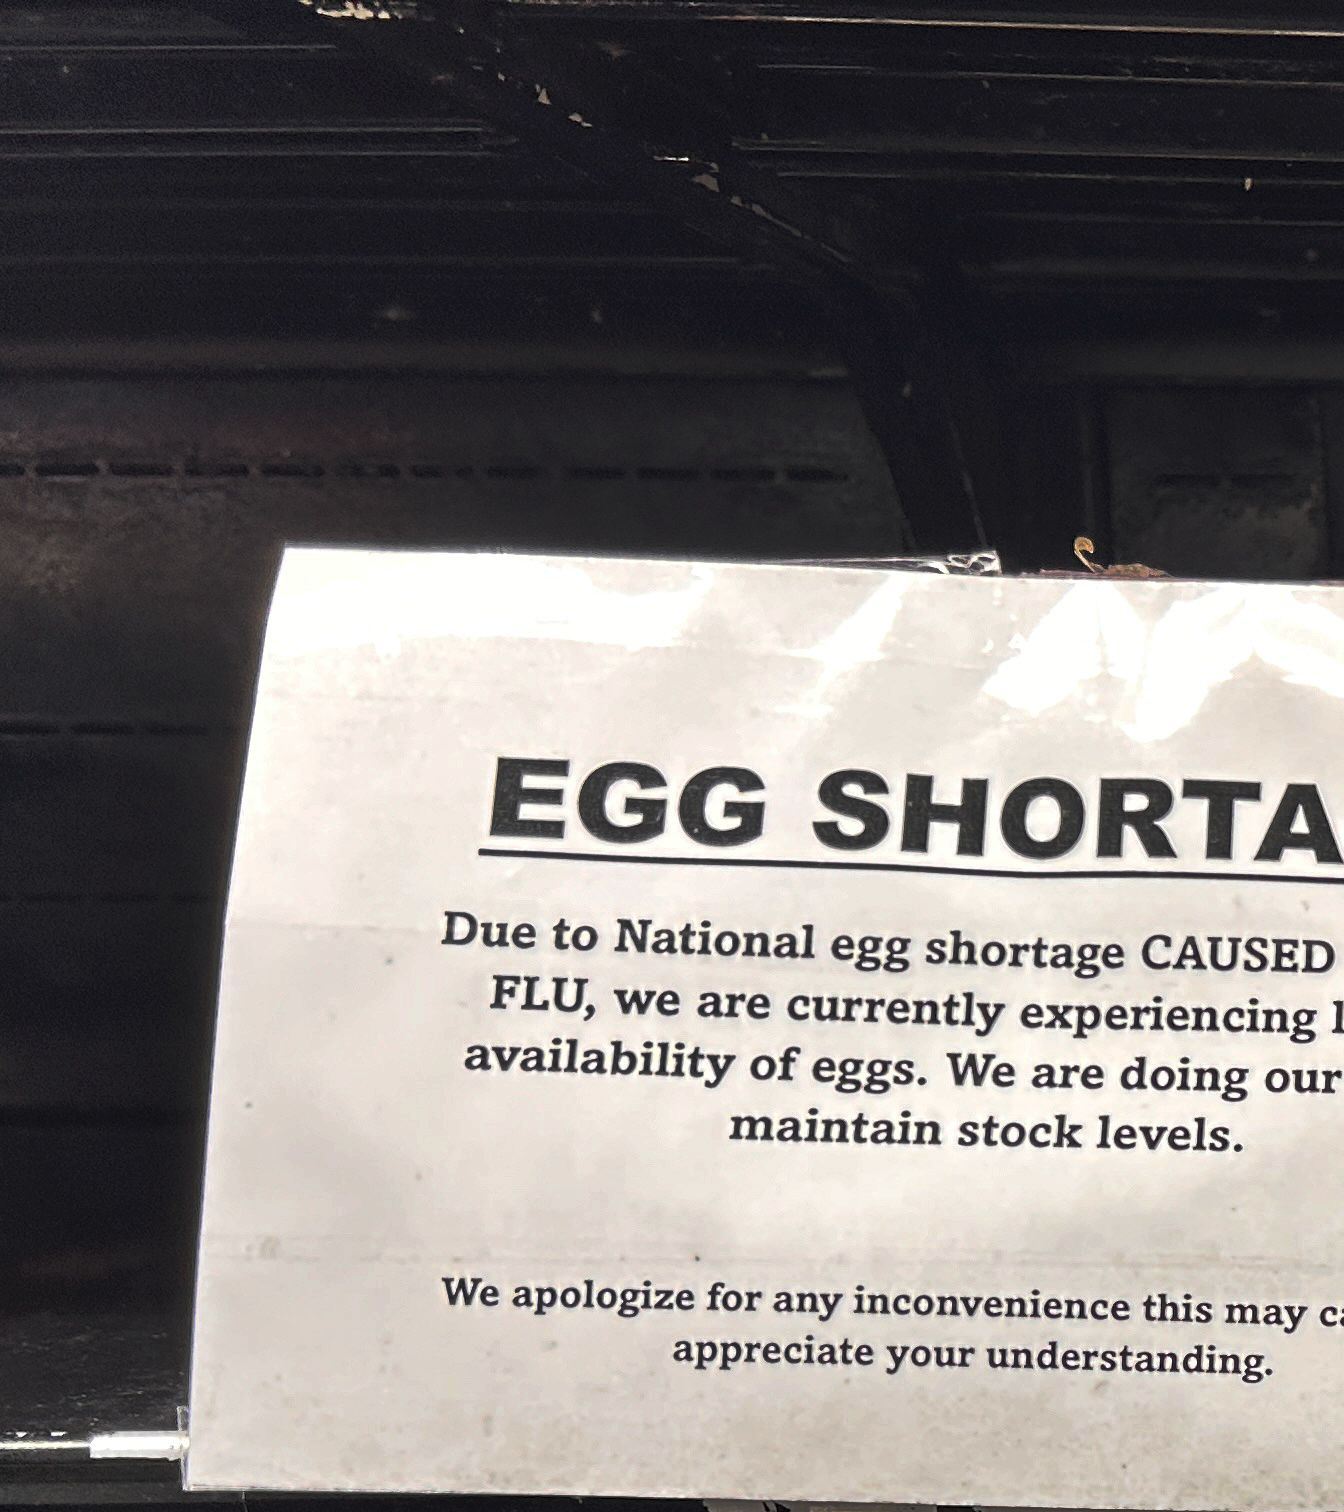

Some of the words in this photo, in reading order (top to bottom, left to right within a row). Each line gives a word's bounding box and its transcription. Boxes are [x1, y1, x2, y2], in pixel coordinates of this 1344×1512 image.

[490, 757, 765, 847] EGG
[441, 911, 536, 949] Due
[553, 918, 598, 951] to
[614, 919, 815, 959] National
[831, 935, 911, 973] egg
[926, 930, 1124, 979] shortage
[1142, 935, 1335, 973] CAUSED
[490, 975, 595, 1021] FLU,
[614, 990, 680, 1016] we
[697, 992, 770, 1019] are
[787, 992, 1006, 1037] currently
[1020, 996, 1317, 1044] experiencing
[465, 1038, 736, 1088] availability
[750, 1046, 801, 1081] of
[812, 1057, 927, 1094] eggs.
[946, 1053, 1015, 1087] We
[1032, 1064, 1104, 1089] are
[1121, 1057, 1249, 1102] doing
[1265, 1068, 1342, 1093] our
[729, 1108, 941, 1145] maintain
[958, 1114, 1083, 1148] stock
[1097, 1115, 1243, 1152] levels.
[442, 1277, 499, 1306] We
[512, 1279, 694, 1318] apologize
[707, 1282, 762, 1311] for
[773, 1292, 843, 1322] any
[853, 1285, 1130, 1321] inconvenience
[1143, 1293, 1212, 1323] this
[1225, 1304, 1308, 1334] may
[673, 1335, 874, 1370] appreciate
[886, 1346, 975, 1375] your
[986, 1341, 1273, 1383] understanding.
